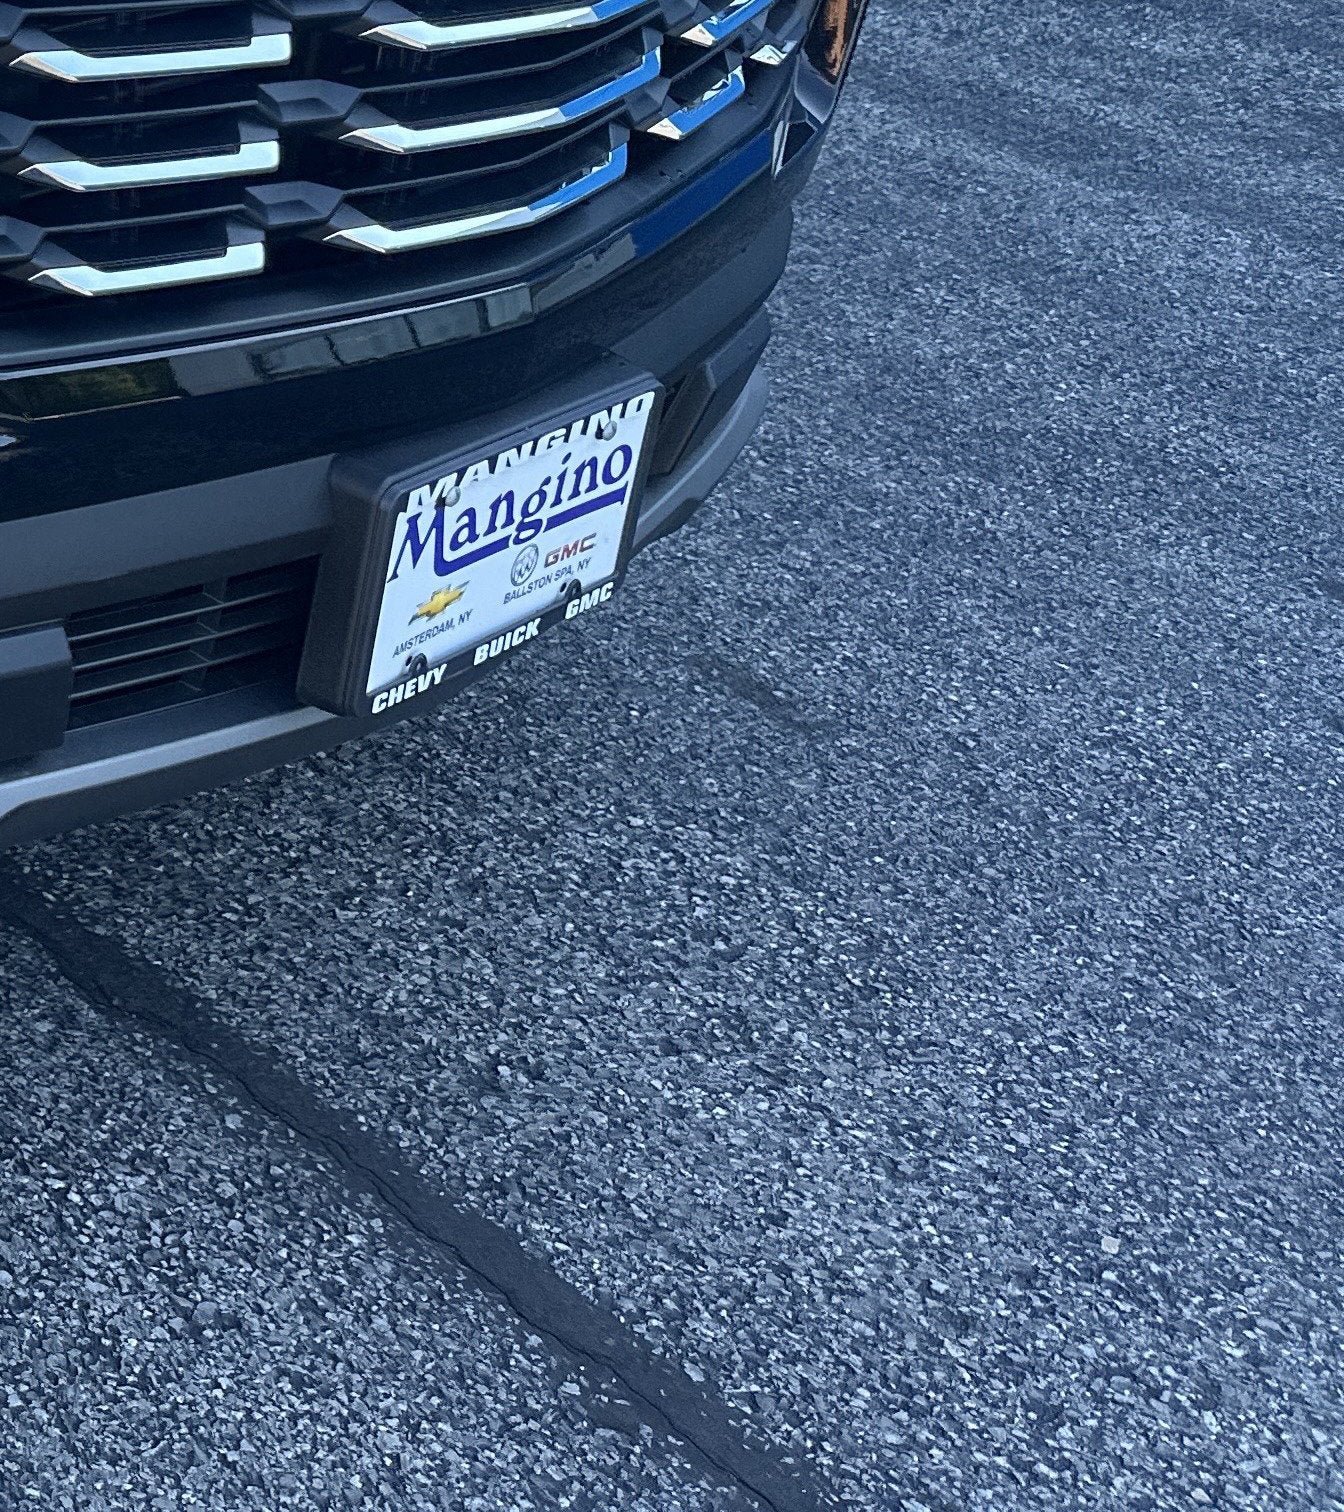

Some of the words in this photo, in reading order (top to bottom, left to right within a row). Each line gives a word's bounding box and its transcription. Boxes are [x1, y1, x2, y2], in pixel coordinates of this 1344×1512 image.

[405, 391, 655, 514] MANGINO
[386, 444, 633, 584] Mangino
[544, 532, 597, 568] GMC
[503, 572, 553, 605] BALLSTON
[554, 566, 575, 583] SPA,
[577, 556, 593, 572] NY
[371, 663, 448, 714] CHEVY
[473, 618, 541, 666] BUICK
[564, 581, 614, 620] GMC
[392, 619, 456, 658] AMSTERDAM,
[458, 608, 474, 625] NY
